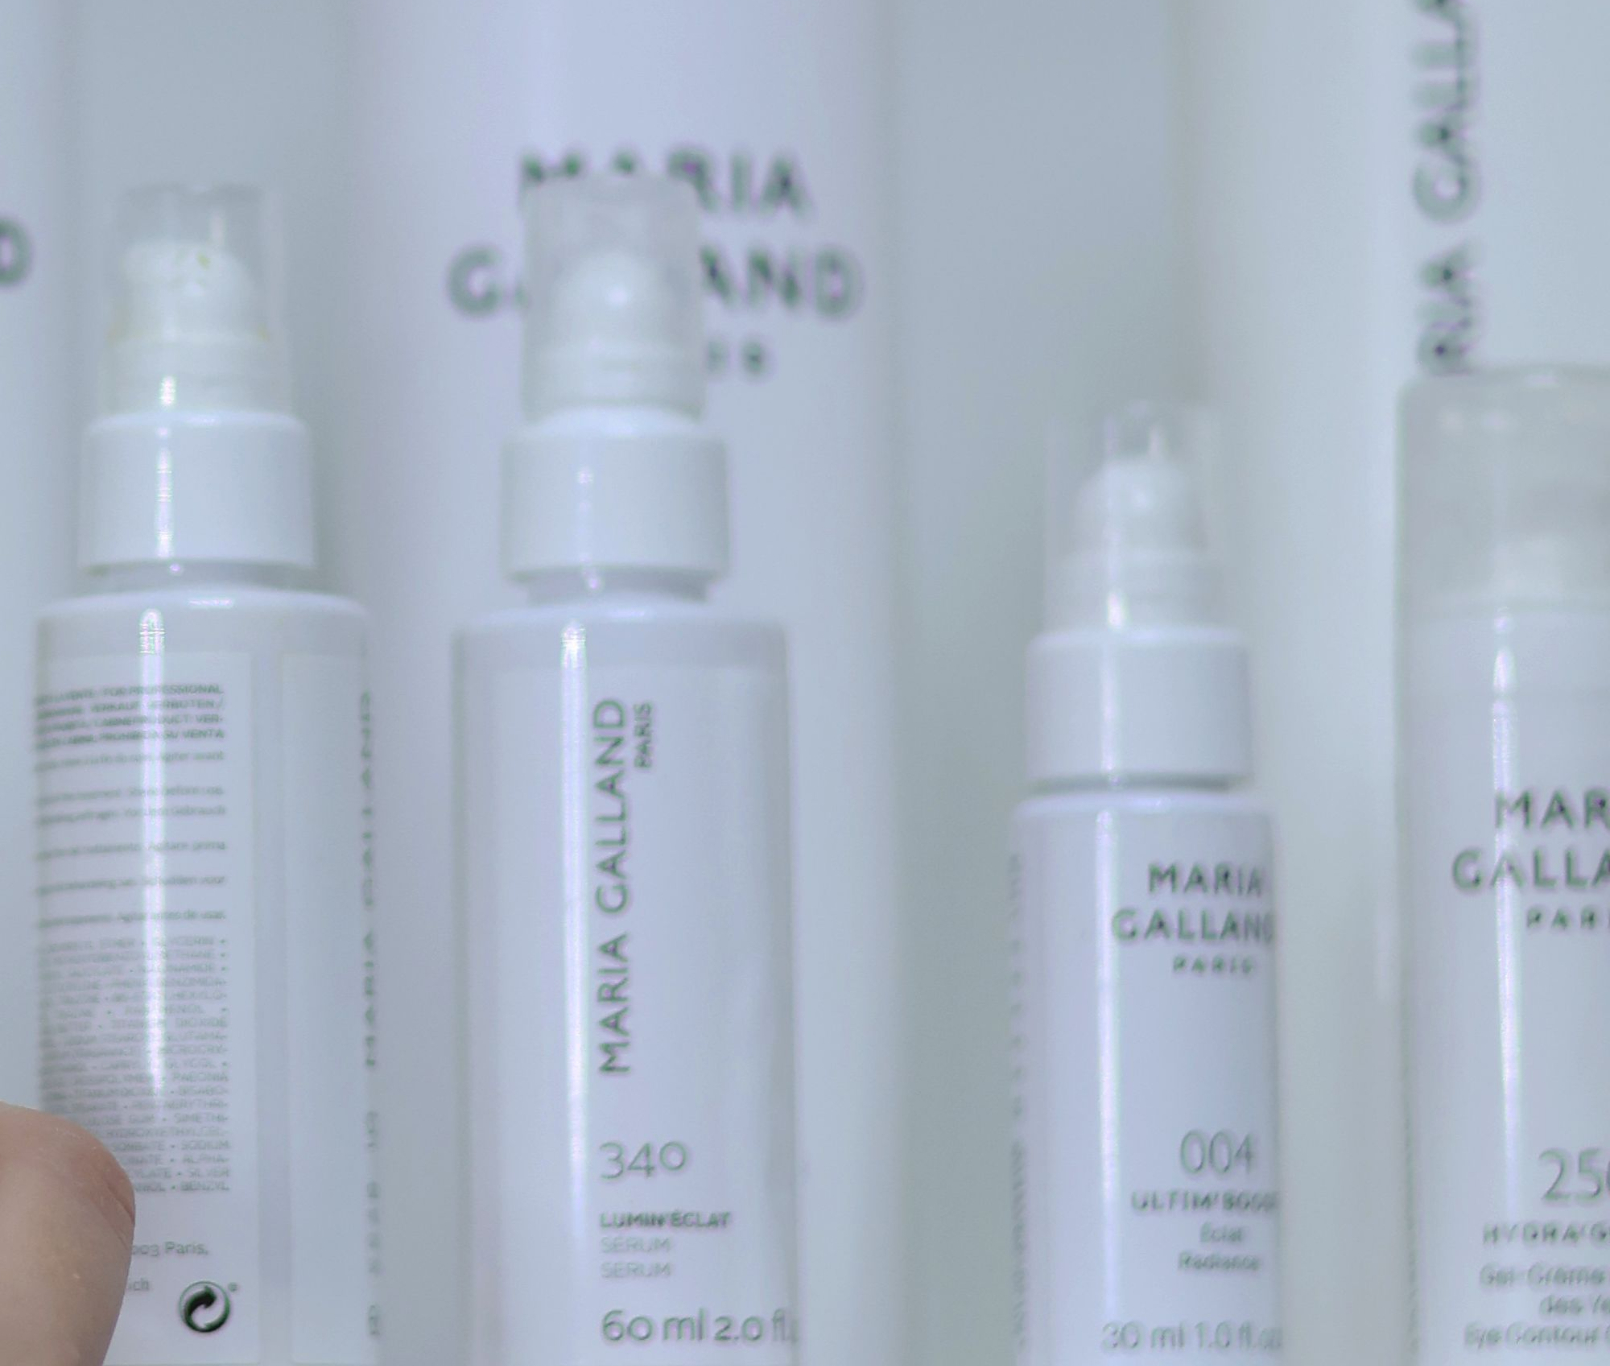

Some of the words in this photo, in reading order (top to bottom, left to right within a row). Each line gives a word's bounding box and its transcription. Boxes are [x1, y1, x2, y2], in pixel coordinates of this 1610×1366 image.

[633, 702, 653, 769] PARIS
[593, 699, 630, 914] GALLAND
[1148, 863, 1264, 897] MARIA
[598, 934, 631, 1075] MARIA
[599, 1140, 688, 1179] 340
[1180, 1130, 1255, 1175] 004
[1539, 1148, 1610, 1202] 25
[601, 1309, 654, 1341] 60
[663, 1307, 706, 1341] ml
[714, 1315, 765, 1341] 2.0
[1150, 1320, 1186, 1349] ml
